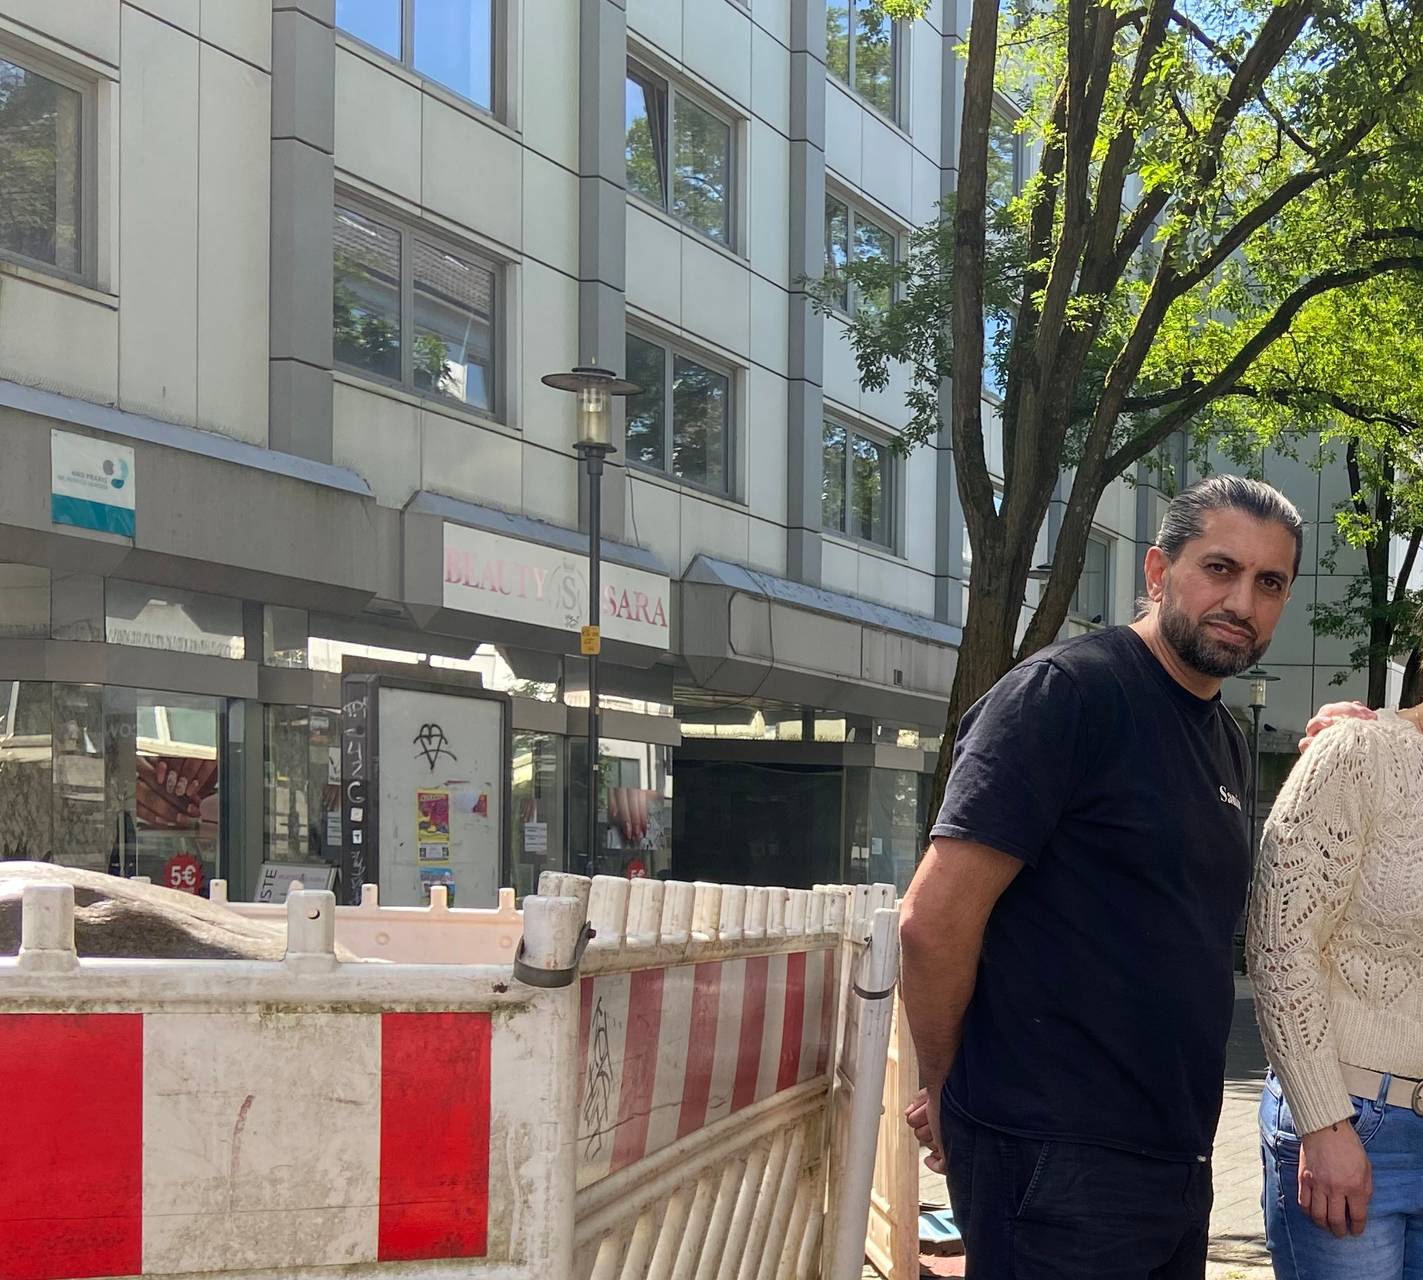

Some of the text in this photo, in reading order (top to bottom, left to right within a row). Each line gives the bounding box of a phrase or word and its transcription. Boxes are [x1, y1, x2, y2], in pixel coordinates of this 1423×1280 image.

[445, 549, 548, 601] BEAUTY
[602, 583, 668, 628] SARA
[171, 864, 196, 887] 5€
